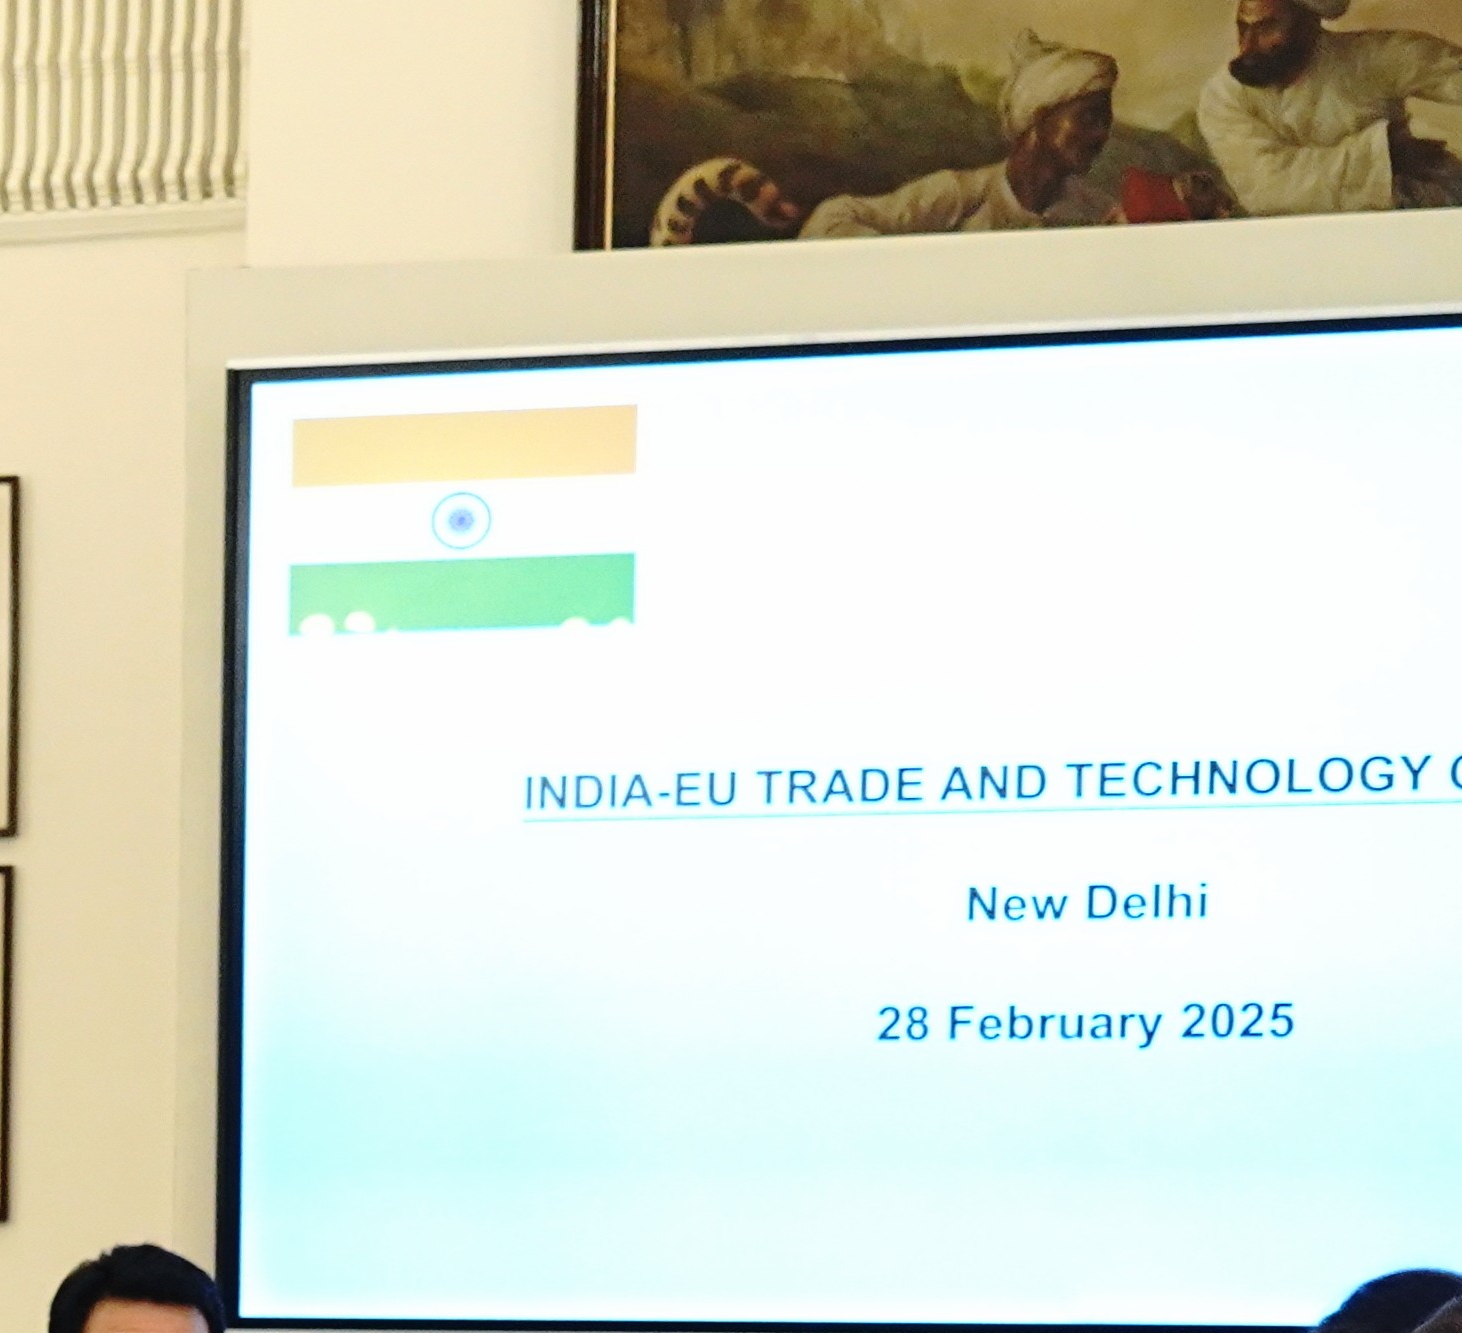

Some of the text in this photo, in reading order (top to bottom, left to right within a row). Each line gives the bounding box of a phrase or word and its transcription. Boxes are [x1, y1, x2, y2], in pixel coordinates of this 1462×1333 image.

[526, 771, 736, 810] INDIA-EU
[756, 767, 924, 805] TRADE
[940, 764, 1046, 801] AND
[1065, 754, 1433, 799] TECHNOLOGY
[967, 882, 1207, 922] New Delhi
[876, 1001, 1294, 1051] 28 February 2025
